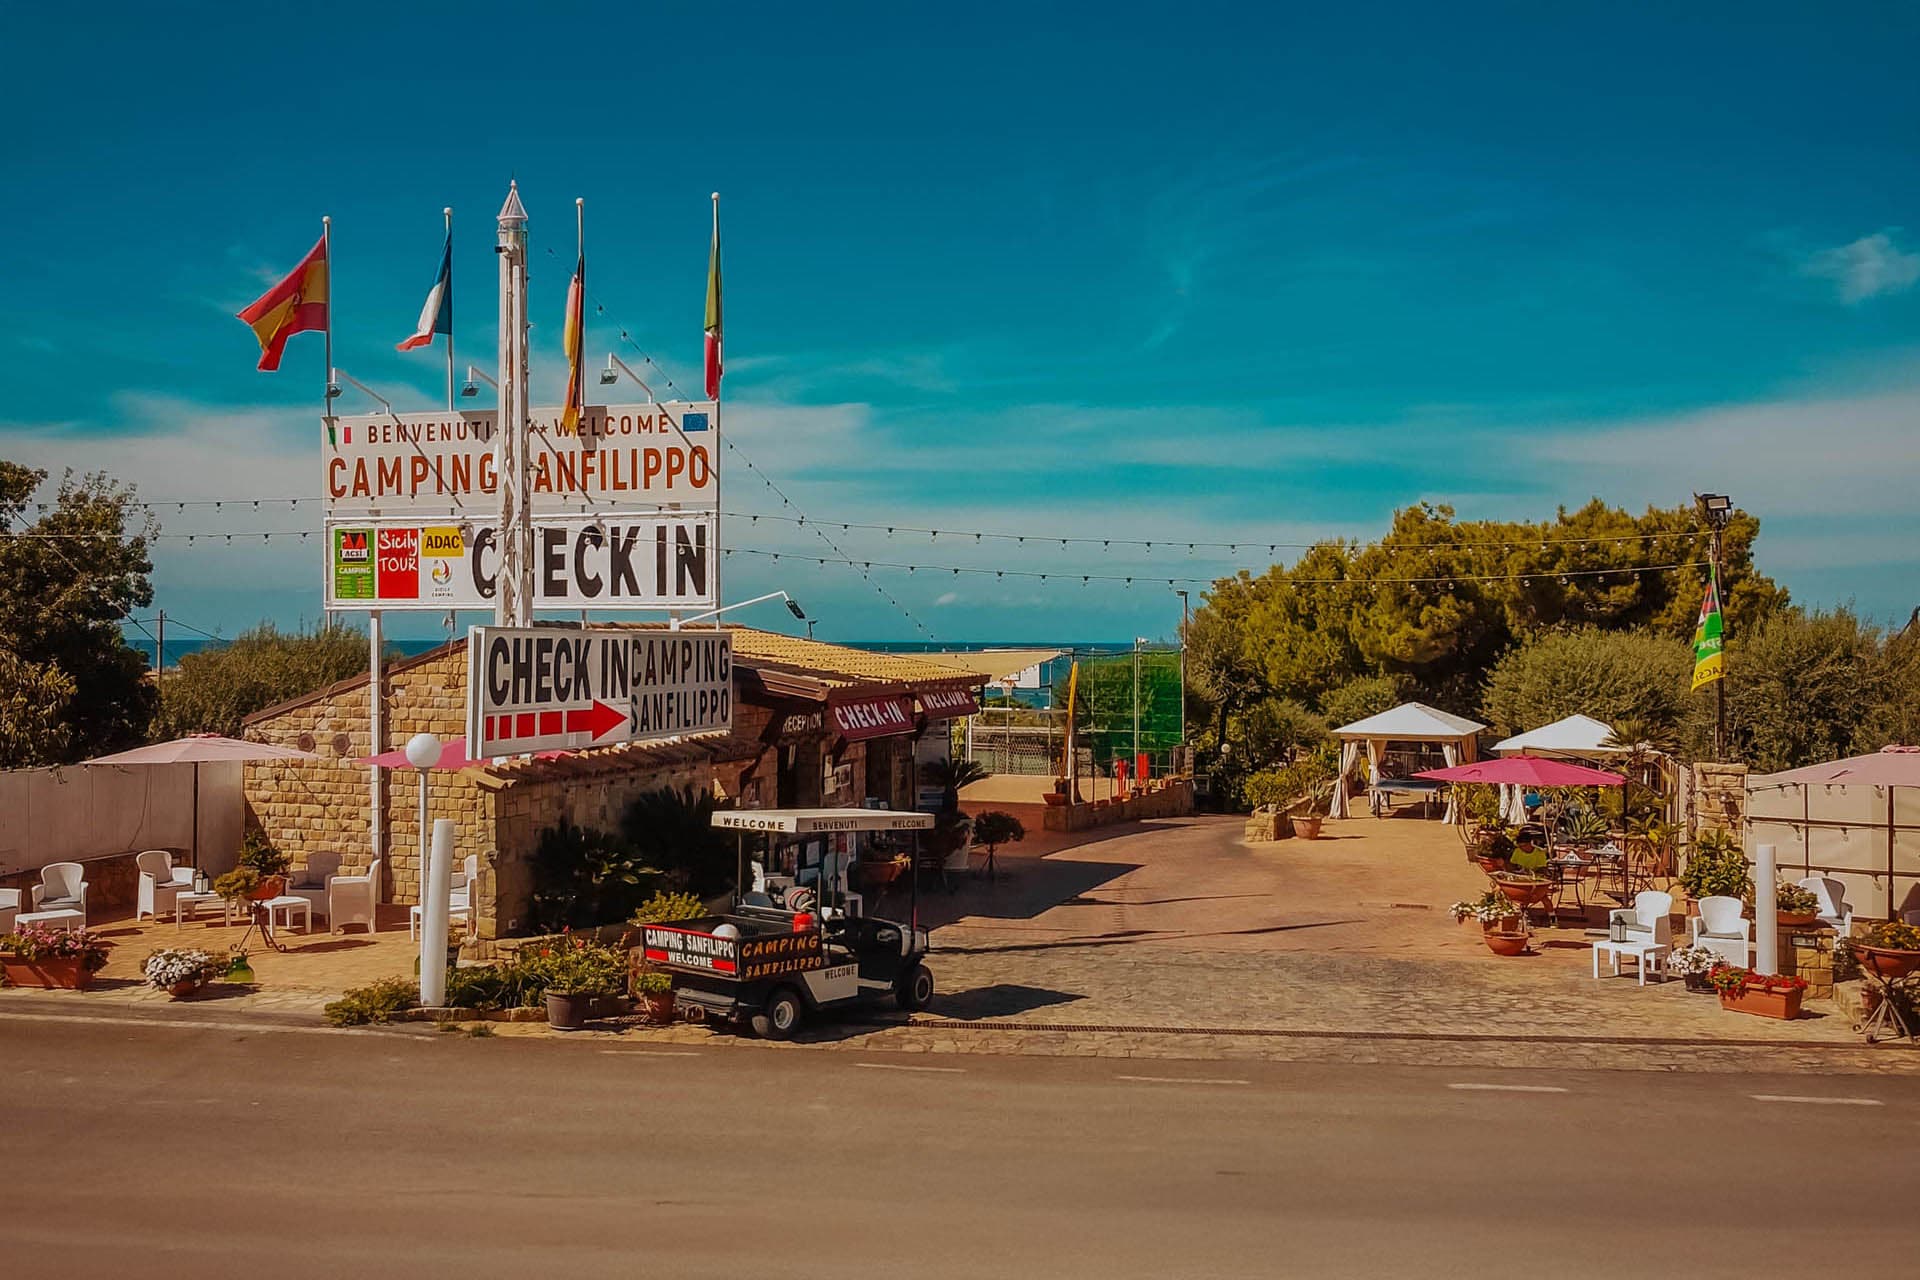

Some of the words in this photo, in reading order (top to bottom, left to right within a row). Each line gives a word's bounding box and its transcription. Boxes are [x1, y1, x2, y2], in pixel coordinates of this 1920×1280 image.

[368, 420, 490, 444] BENVENUTI
[554, 413, 669, 438] WELCOME
[329, 452, 498, 498] CAMPING
[534, 445, 710, 493] ANFILIPPO
[378, 530, 418, 556] Sicily
[425, 535, 460, 549] ADAC
[339, 566, 371, 574] CAMPING
[379, 556, 418, 572] TOUR
[472, 524, 641, 599] CECK
[656, 524, 706, 597] IN
[489, 636, 592, 706] CHECK
[601, 639, 628, 699] IN
[631, 639, 729, 687] CAMPING
[631, 687, 728, 734] SANFILIPPO
[834, 700, 905, 730] CHECK-IN
[782, 711, 822, 733] RECEPTION
[723, 816, 784, 830] WELCOME
[812, 820, 858, 831] BENVENUTI
[892, 819, 926, 829] WELCOME
[646, 929, 683, 951] CAMPING
[687, 934, 735, 958] SANFILIPPO
[742, 935, 818, 957] CAMPING
[668, 951, 713, 968] WELCOME
[744, 956, 822, 978] SANFILIPPO
[824, 965, 857, 981] WELCOME
